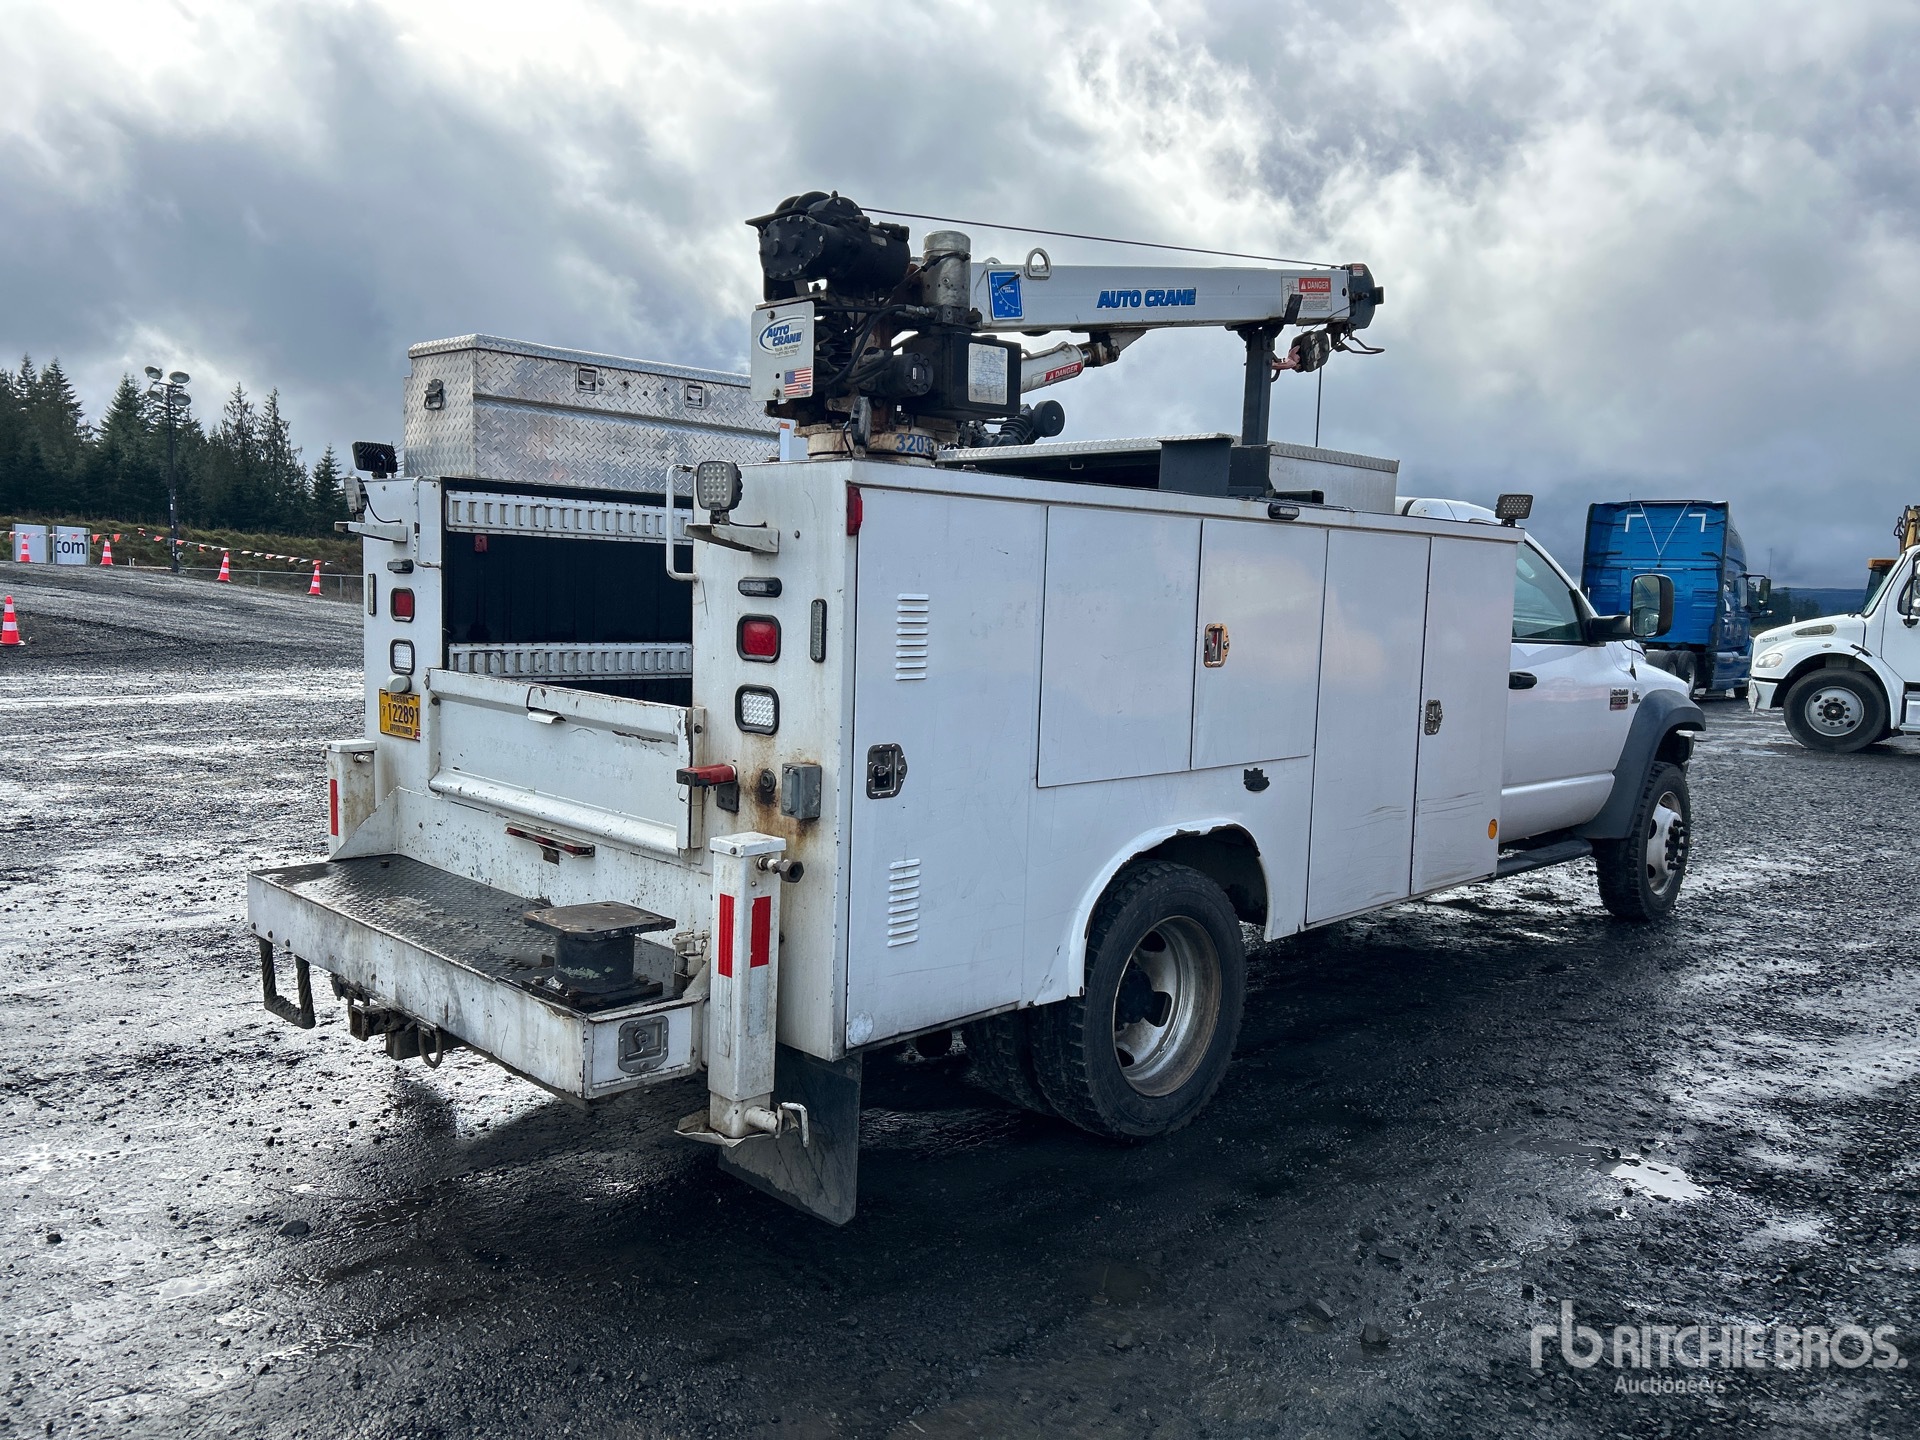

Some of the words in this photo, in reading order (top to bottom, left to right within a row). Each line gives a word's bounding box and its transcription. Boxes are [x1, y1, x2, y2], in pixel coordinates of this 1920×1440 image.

[1307, 281, 1329, 290] DANGER
[1096, 289, 1142, 308] AUTO
[1144, 288, 1196, 307] CRANE
[766, 324, 790, 338] AUTO
[772, 331, 802, 347] CRANE
[1055, 364, 1078, 378] DANGER
